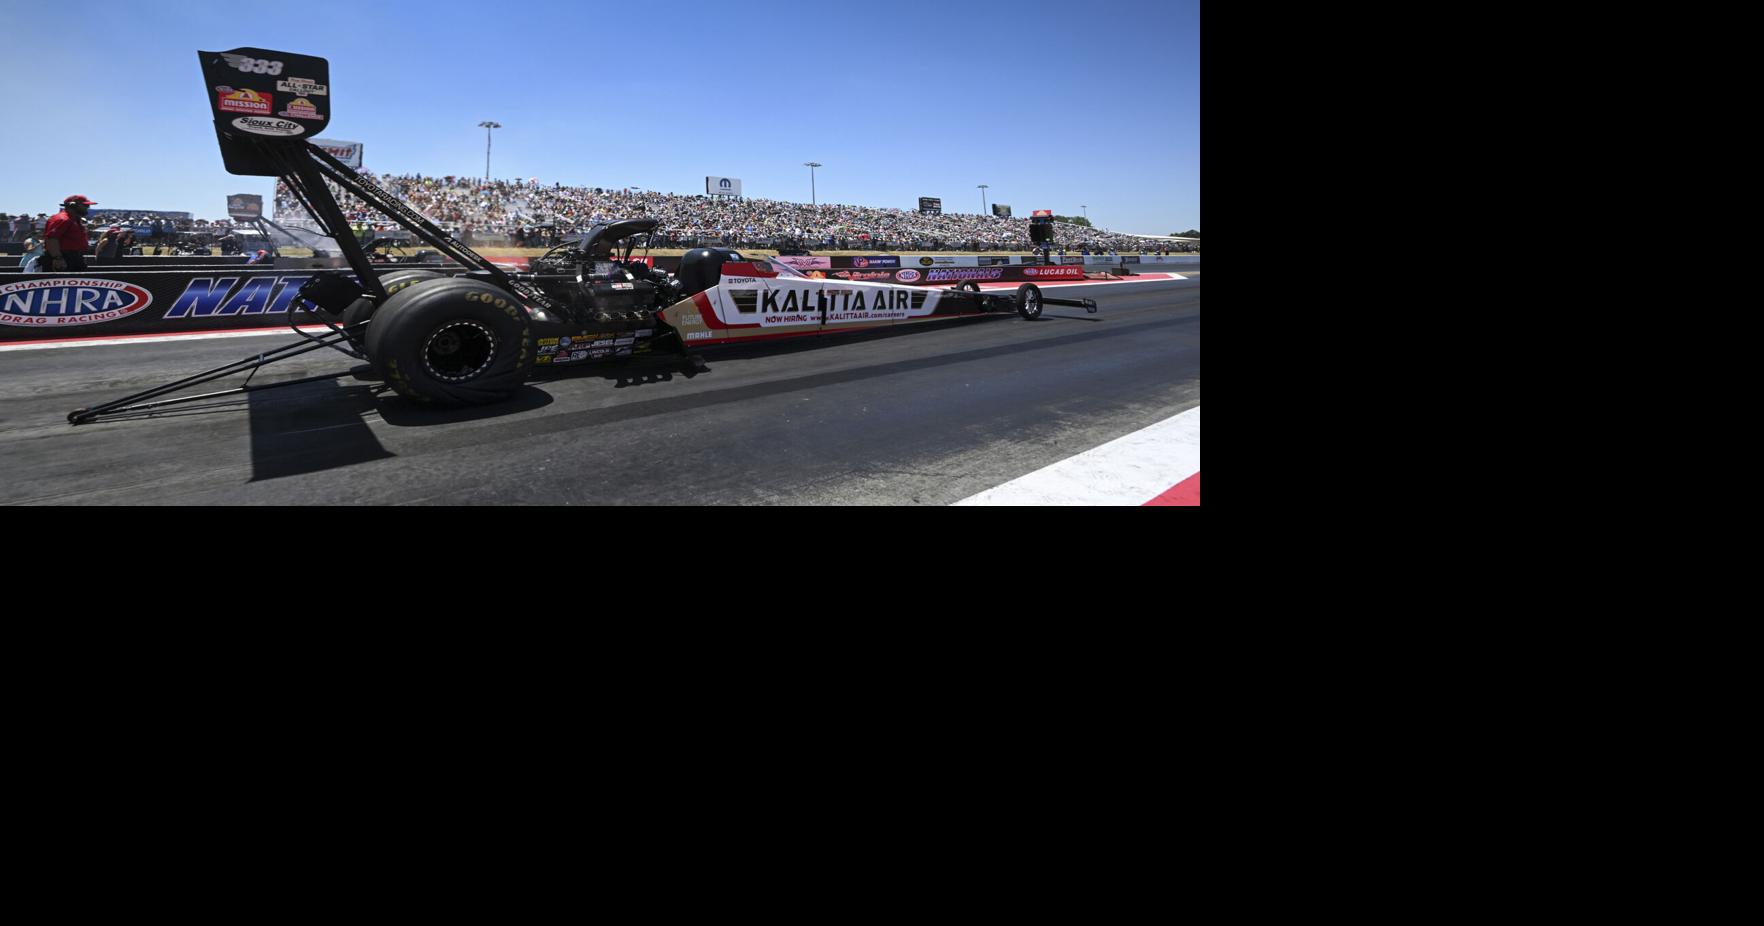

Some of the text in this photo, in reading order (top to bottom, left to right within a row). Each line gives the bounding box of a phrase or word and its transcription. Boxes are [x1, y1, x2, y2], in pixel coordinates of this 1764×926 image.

[238, 57, 283, 75] 333
[224, 99, 268, 109] mission
[240, 117, 273, 128] Sioux
[276, 121, 299, 130] City
[4, 280, 123, 292] CHAMPIONSHIP
[4, 287, 124, 314] NHRA
[872, 289, 908, 310] AIR
[1, 311, 117, 324] DRAG RACING
[765, 316, 782, 324] NOW
[783, 315, 807, 323] HIRING
[687, 331, 712, 339] MAHLE
